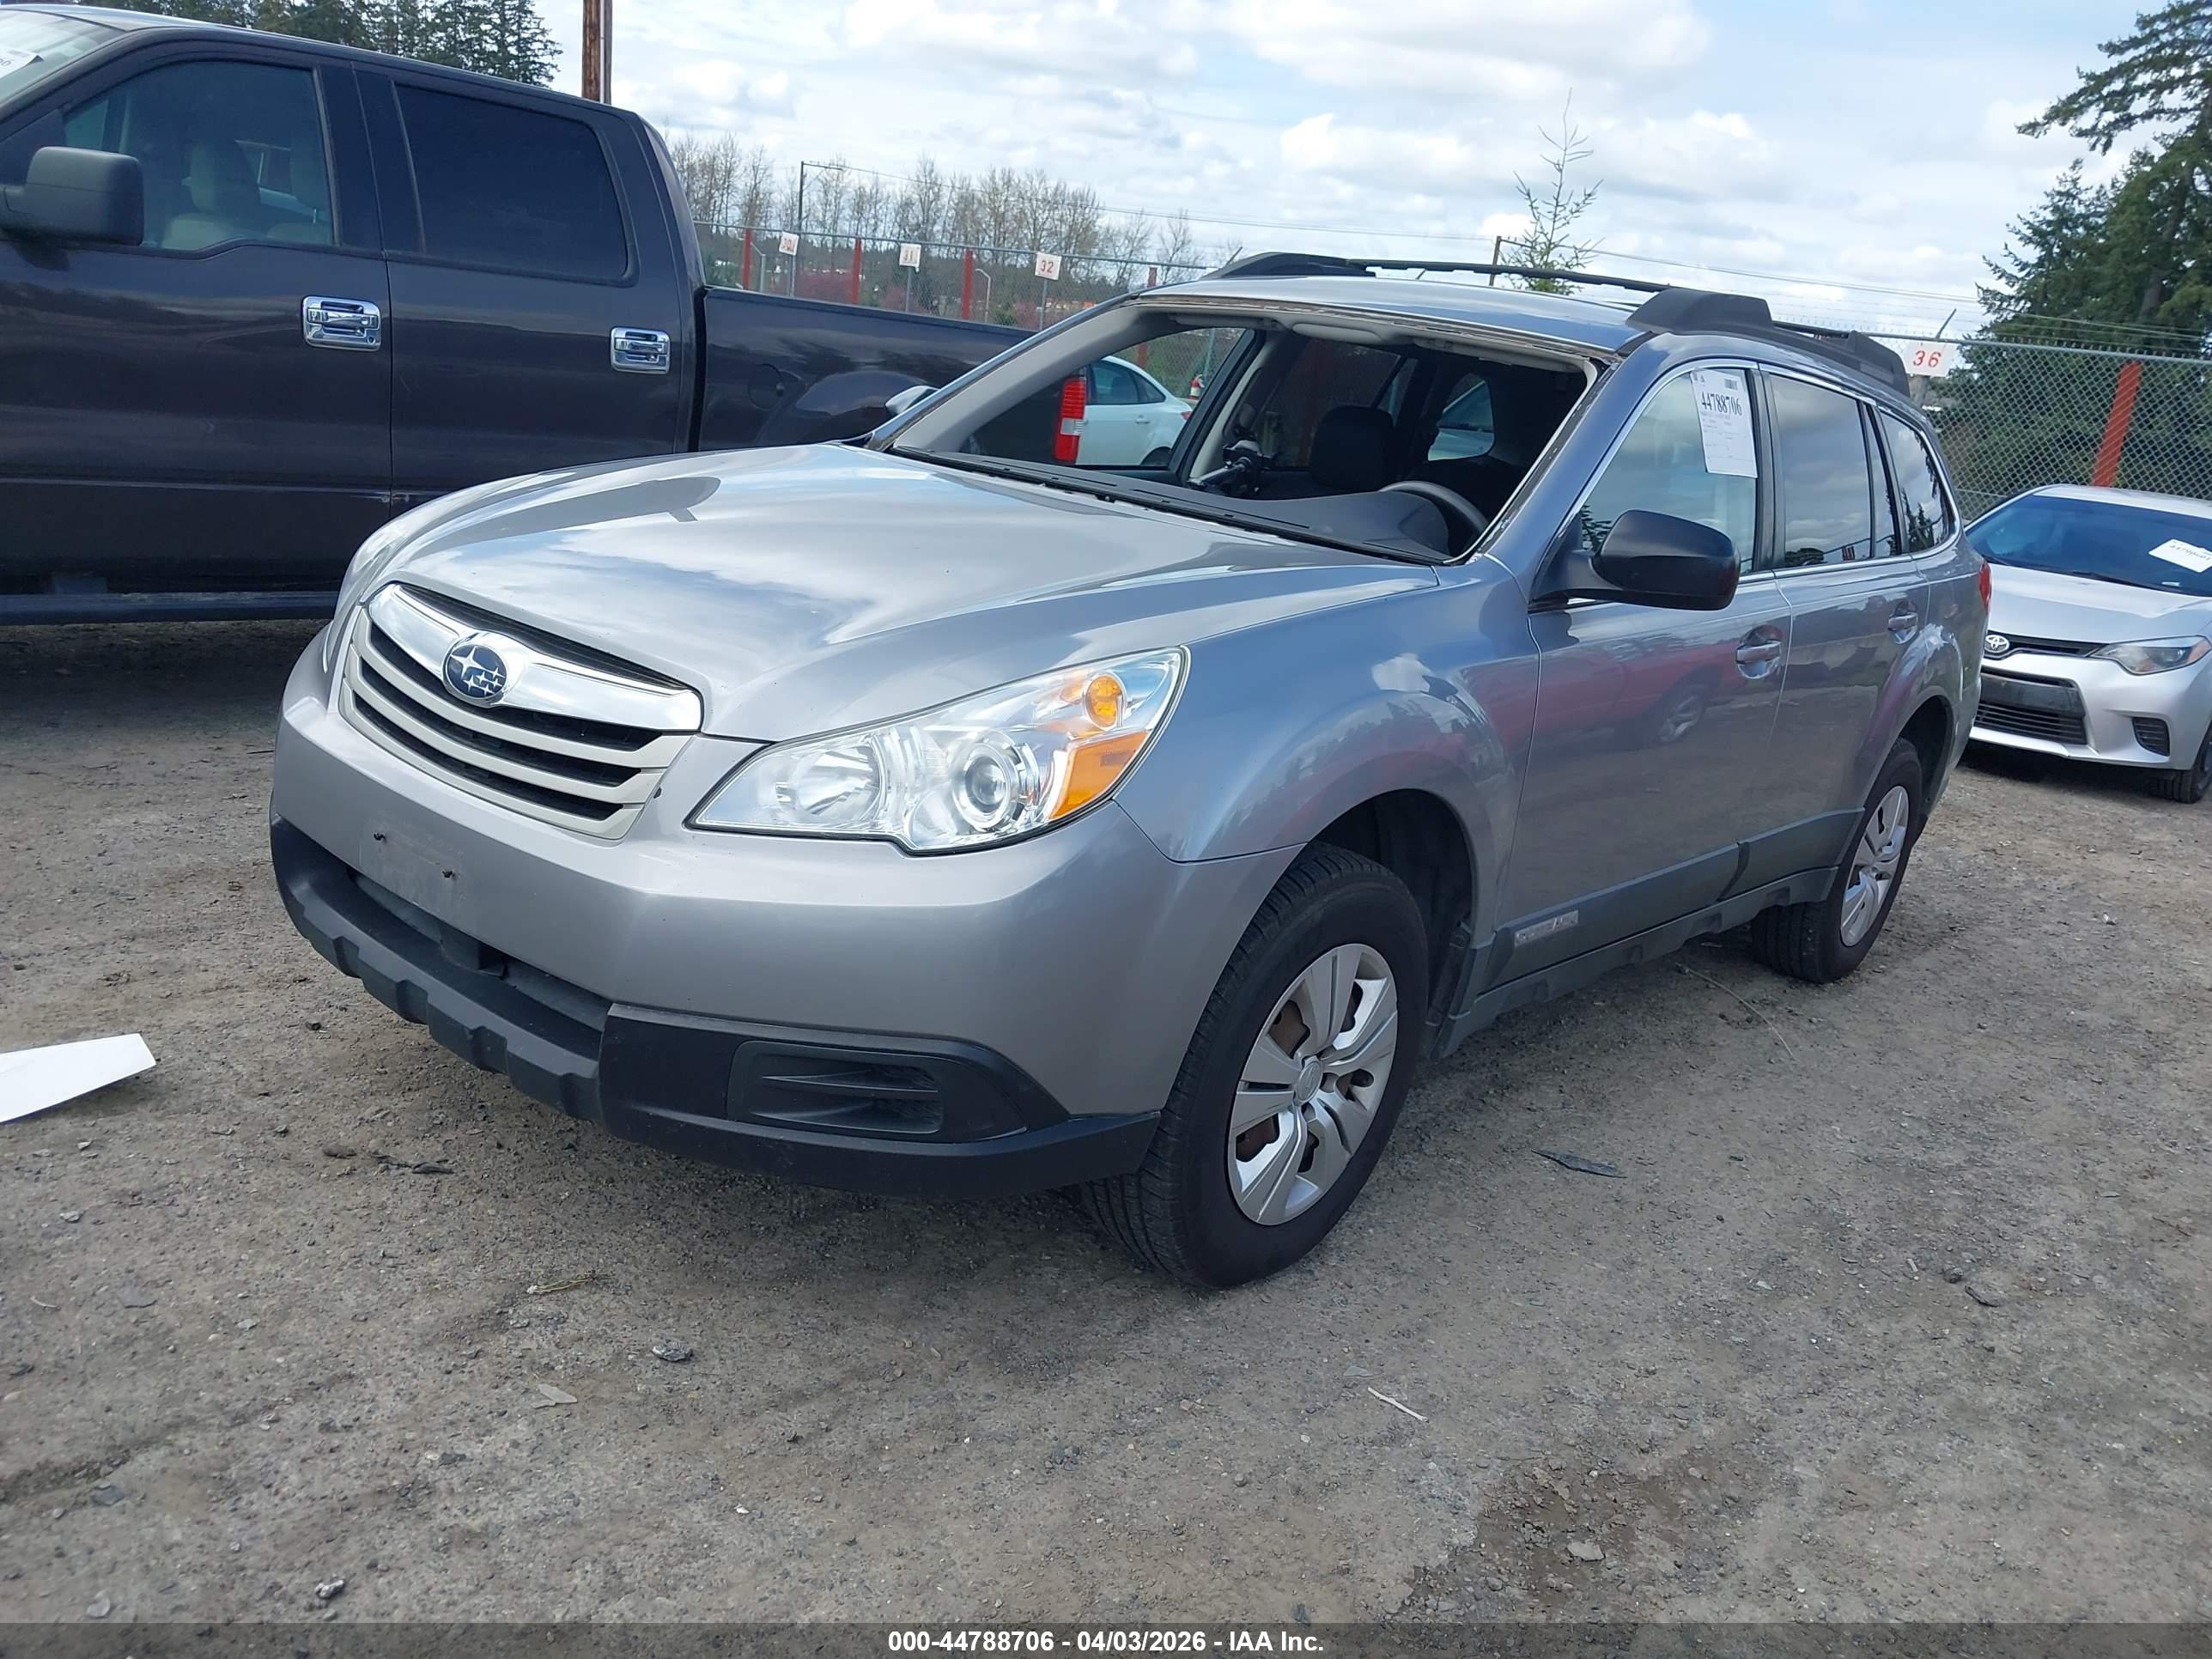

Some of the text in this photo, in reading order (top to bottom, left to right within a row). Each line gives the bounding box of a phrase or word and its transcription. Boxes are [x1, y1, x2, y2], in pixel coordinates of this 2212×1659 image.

[1040, 259, 1054, 274] 32
[1912, 349, 1942, 368] 36
[1701, 391, 1742, 416] 44788706
